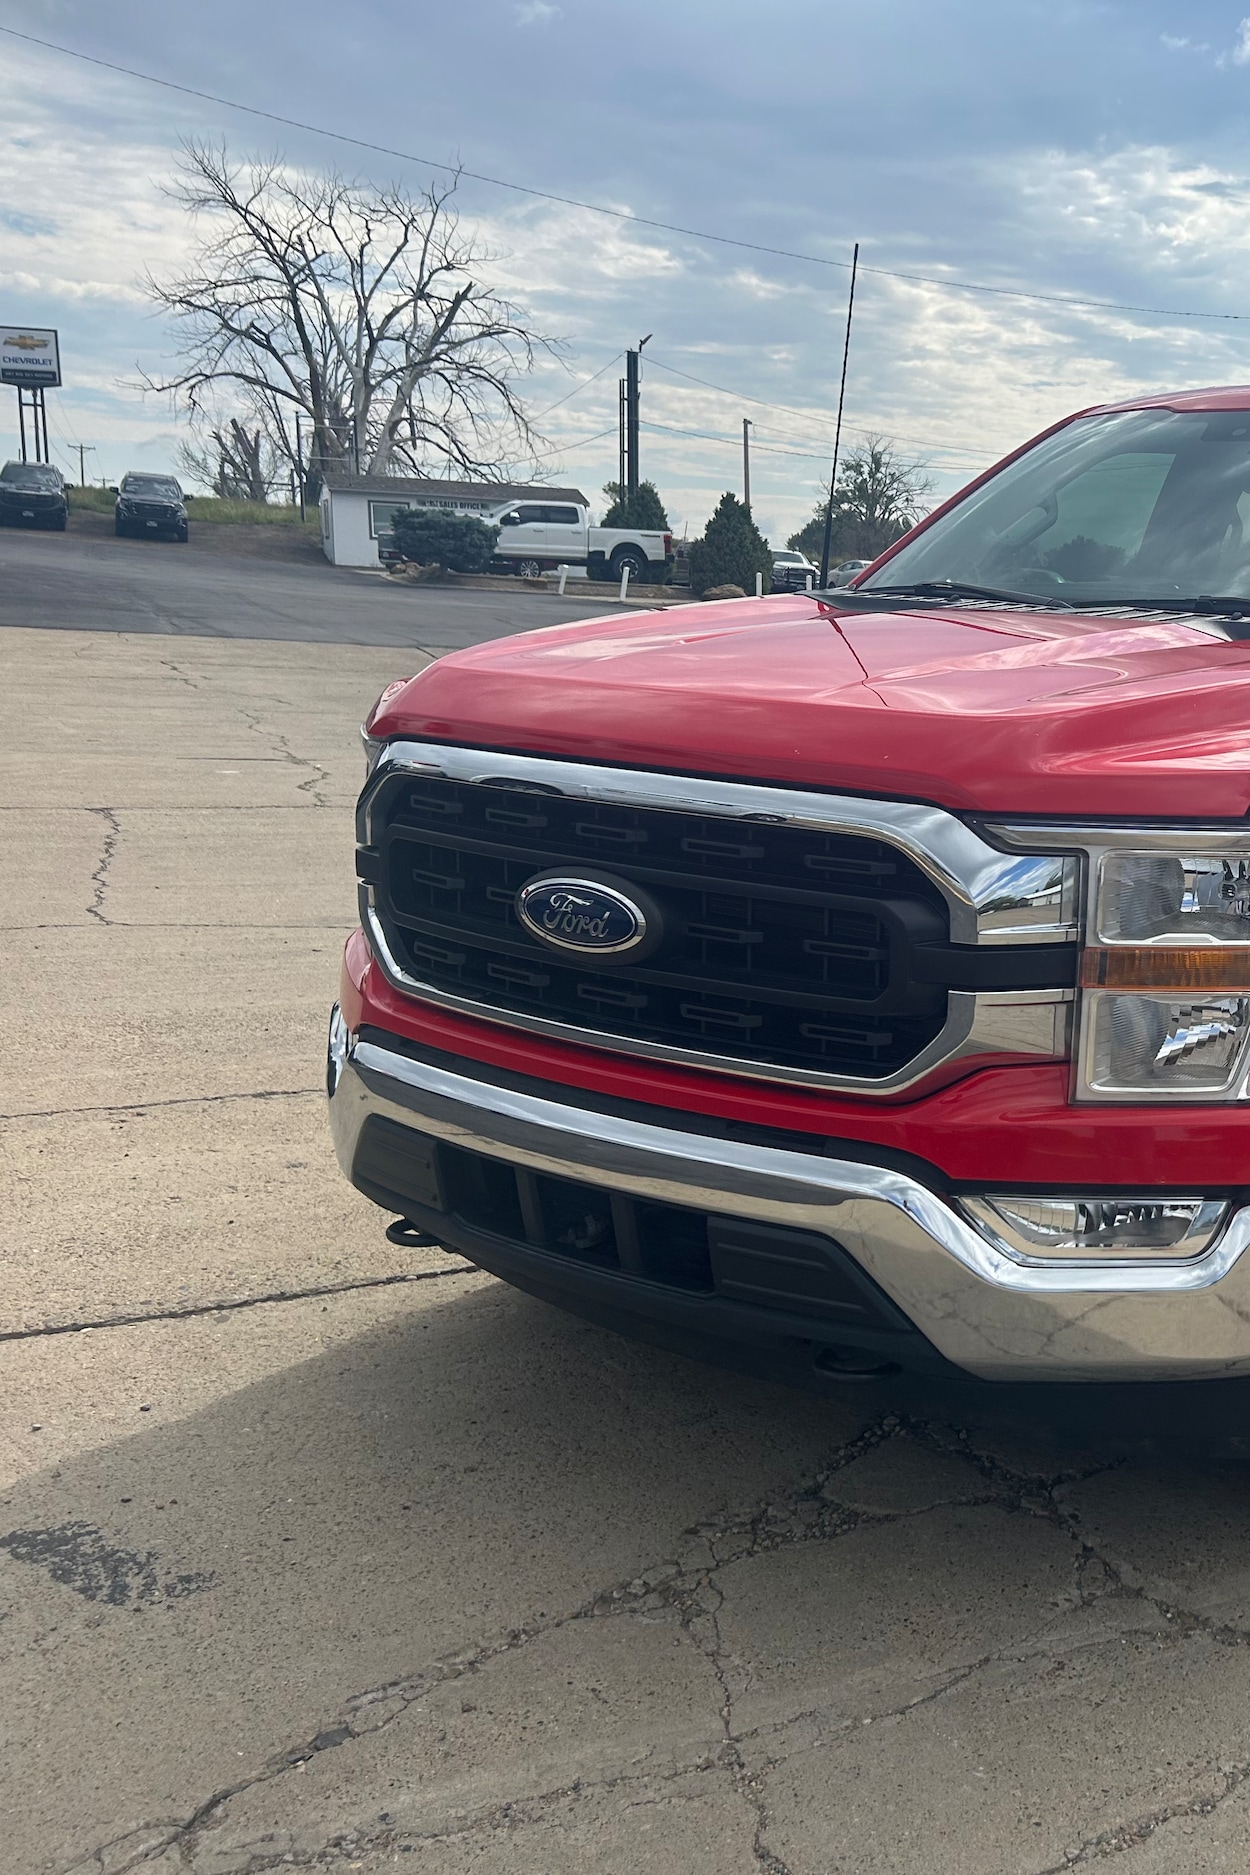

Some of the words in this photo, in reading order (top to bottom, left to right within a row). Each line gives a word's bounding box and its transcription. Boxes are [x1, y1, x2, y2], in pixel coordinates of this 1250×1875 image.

[3, 356, 52, 366] CHEVROLET
[440, 501, 459, 509] SALES
[460, 502, 480, 510] OFFICE
[543, 892, 611, 938] Ford
